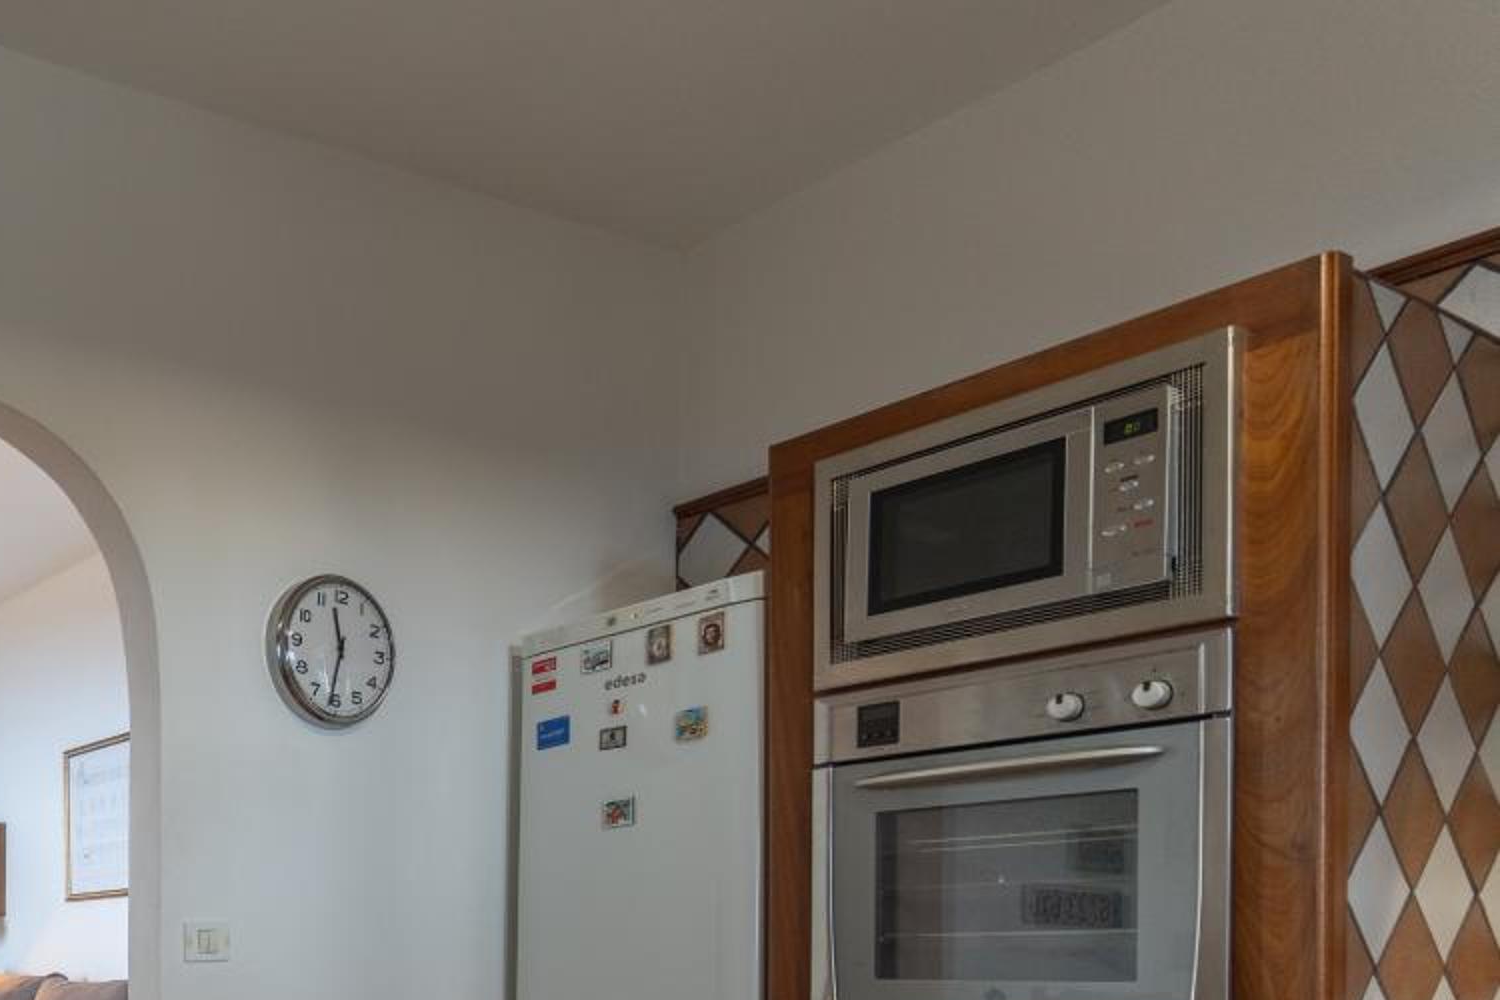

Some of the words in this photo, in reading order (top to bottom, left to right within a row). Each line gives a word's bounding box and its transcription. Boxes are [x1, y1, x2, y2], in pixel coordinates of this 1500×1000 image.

[335, 589, 349, 605] 12
[299, 609, 311, 623] 10
[369, 624, 380, 639] 2
[291, 633, 303, 647] 9
[373, 651, 386, 665] 3
[295, 659, 308, 675] 8
[366, 676, 377, 690] 4
[604, 671, 647, 691] edesa
[310, 682, 321, 697] 7
[351, 691, 363, 705] 5
